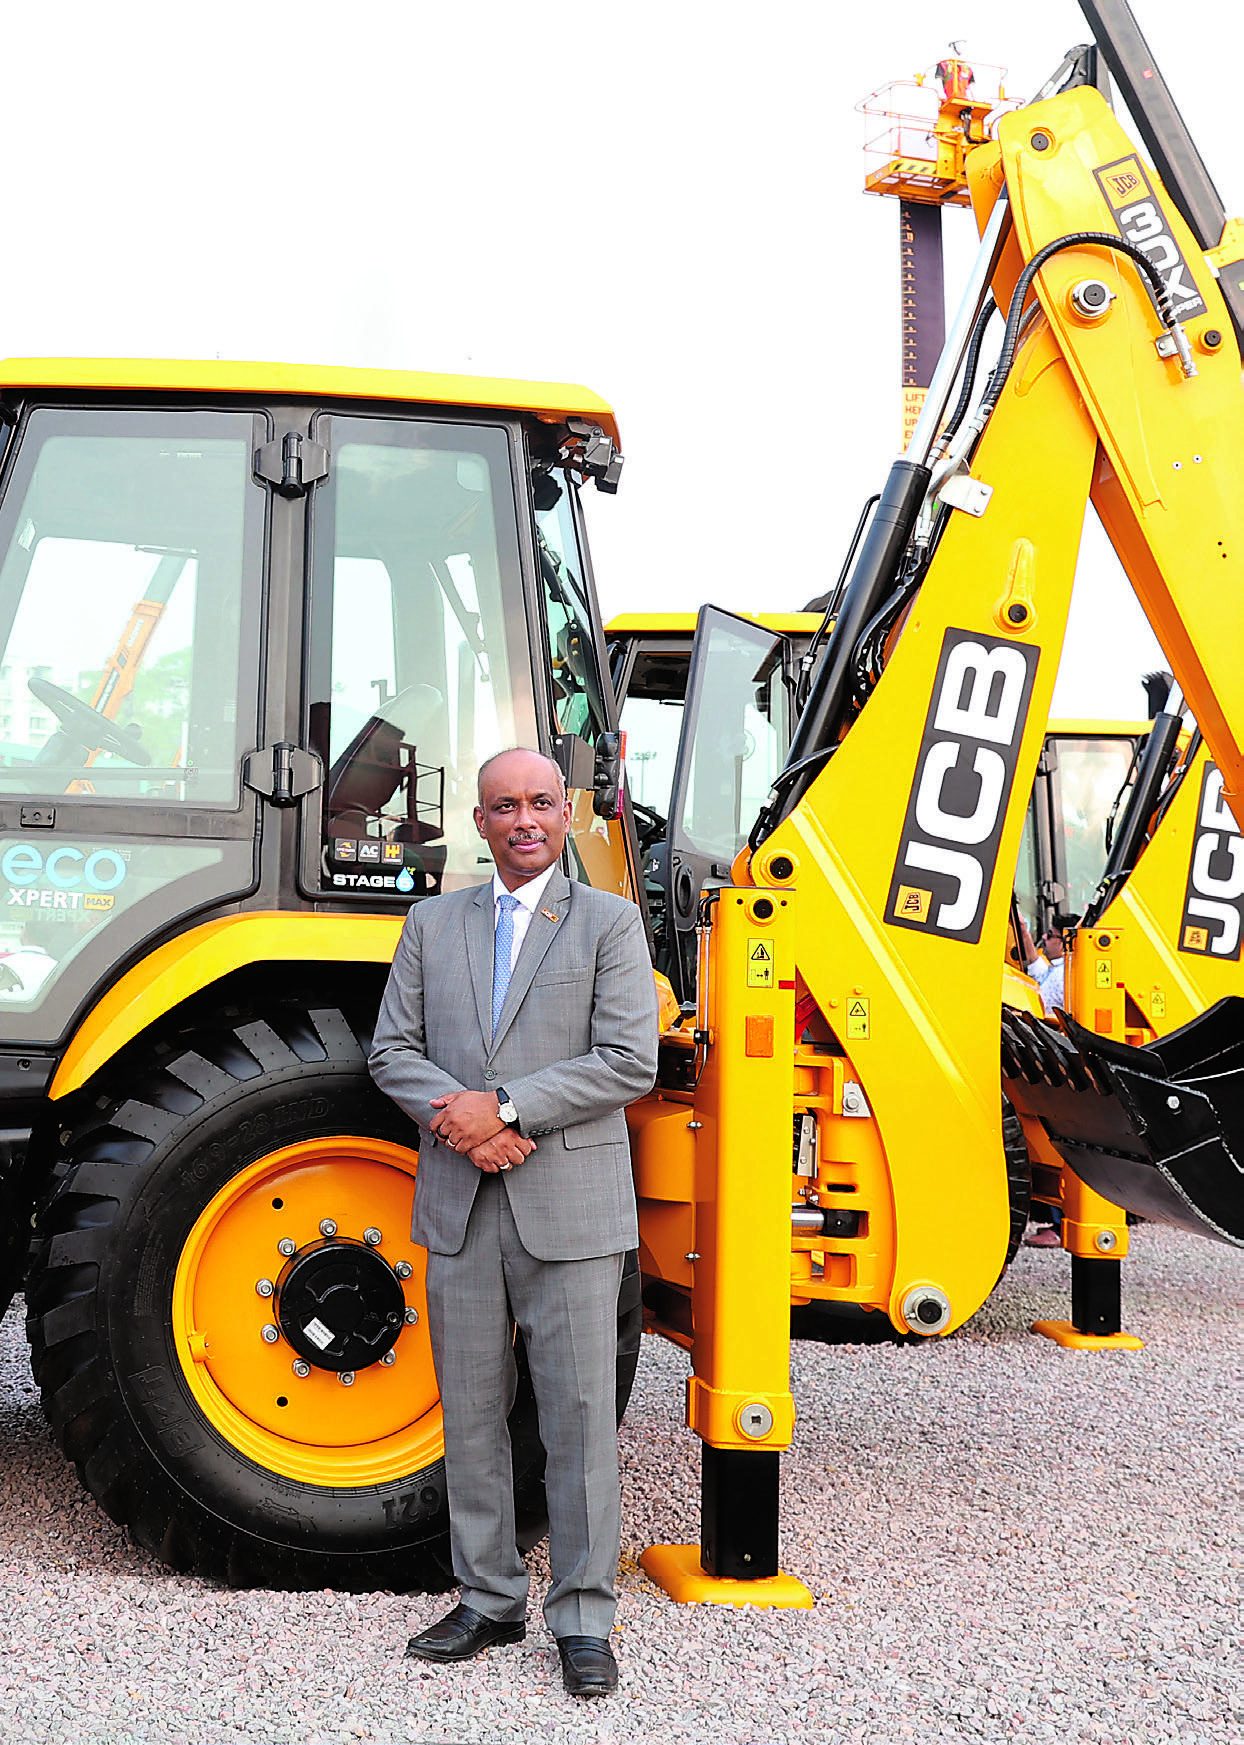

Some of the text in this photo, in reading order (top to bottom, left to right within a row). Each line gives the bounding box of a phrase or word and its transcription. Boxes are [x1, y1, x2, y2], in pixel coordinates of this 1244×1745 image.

[1112, 173, 1138, 195] JCB
[1119, 202, 1199, 303] 3DX
[905, 393, 926, 402] LIFT
[904, 641, 1027, 930] JCB
[360, 845, 379, 855] AC
[2, 844, 126, 891] eco
[333, 874, 396, 887] STAGE
[8, 888, 111, 909] XPERT MAX
[904, 894, 920, 911] JCB
[382, 1486, 443, 1530] 621
